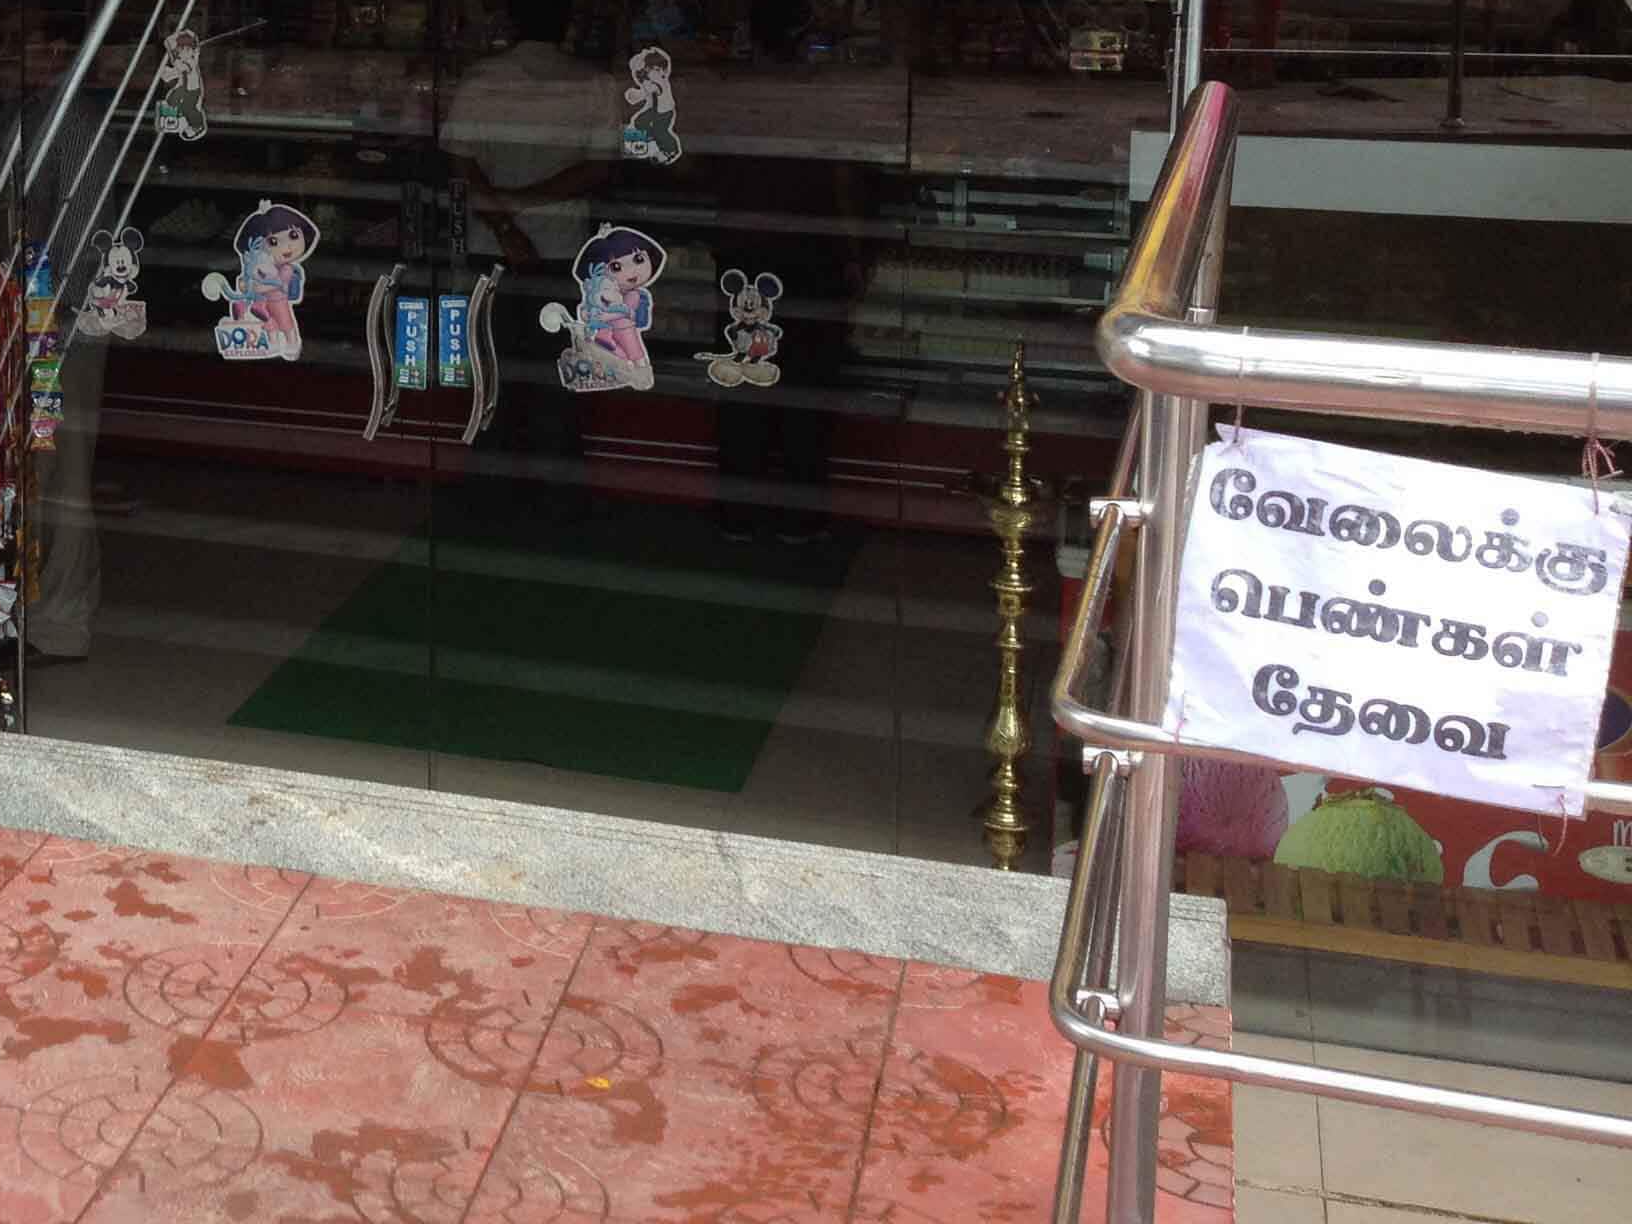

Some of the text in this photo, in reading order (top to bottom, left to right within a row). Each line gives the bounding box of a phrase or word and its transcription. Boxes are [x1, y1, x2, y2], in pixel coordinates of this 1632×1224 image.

[218, 328, 269, 350] DORA
[405, 311, 418, 367] PUSH
[449, 309, 461, 365] PUSH
[1209, 467, 1608, 596] வேலைக்கு
[1210, 568, 1583, 676] பெண்கள்
[1251, 664, 1511, 760] தேவை
